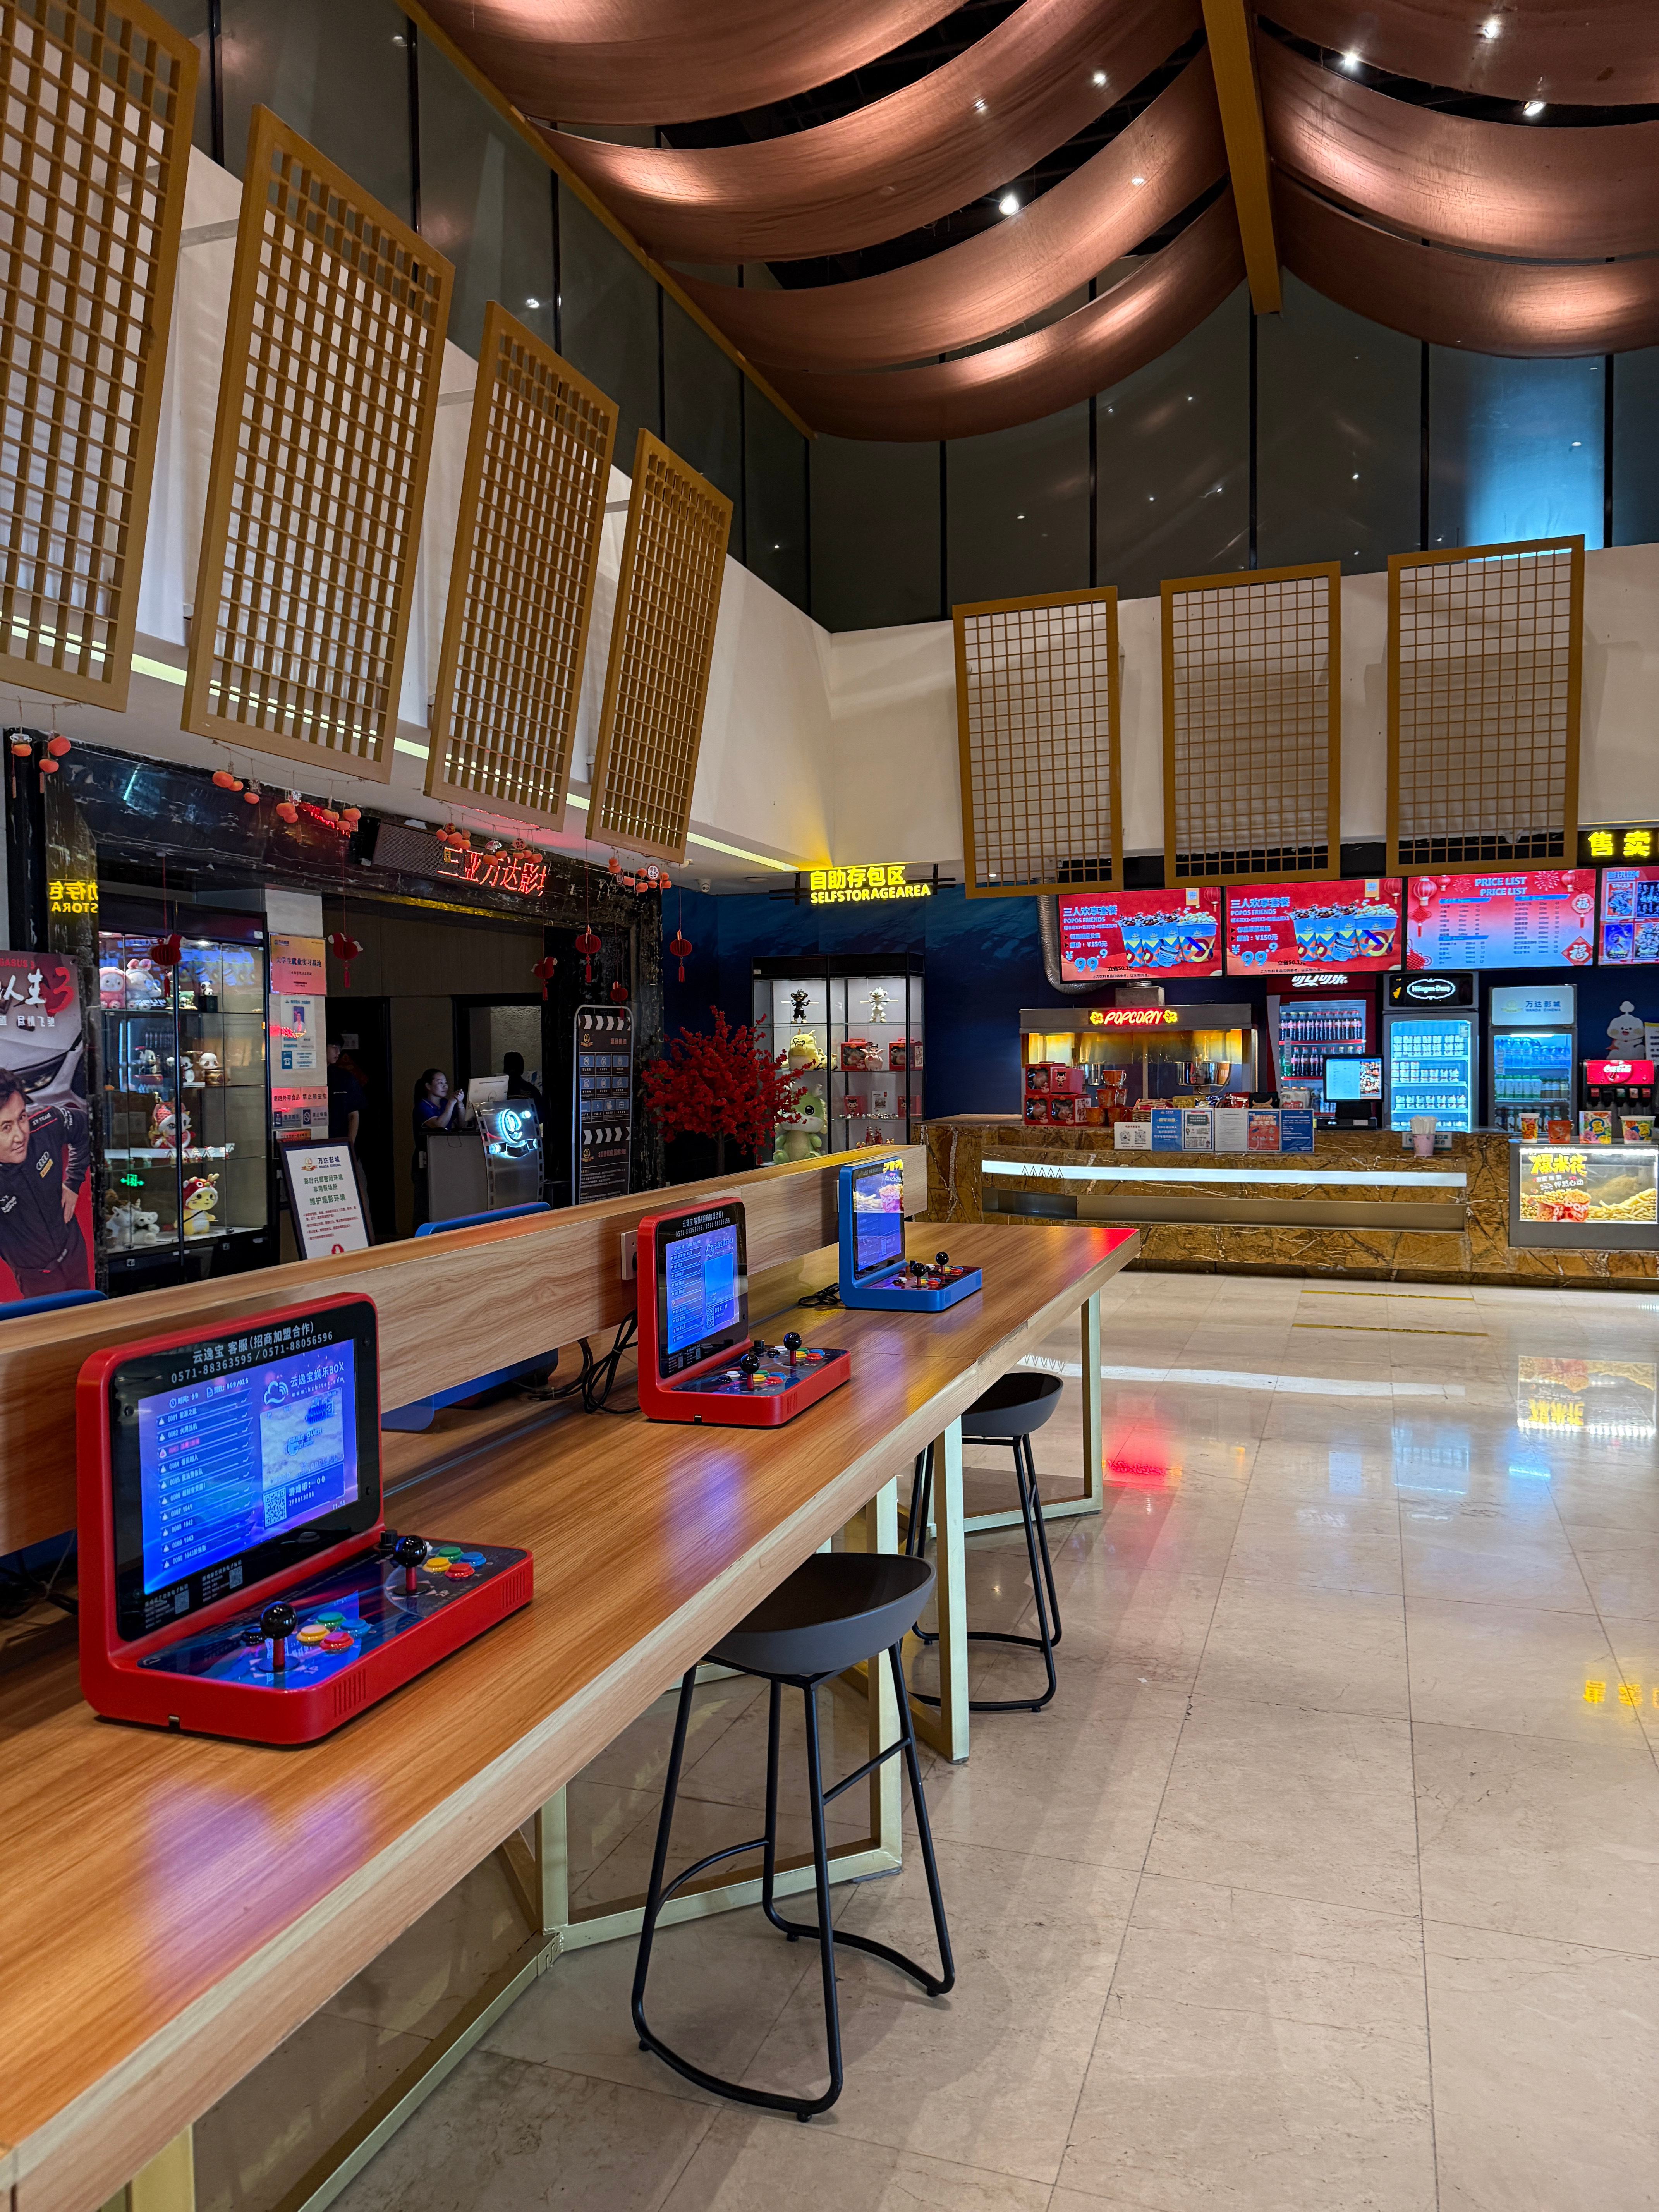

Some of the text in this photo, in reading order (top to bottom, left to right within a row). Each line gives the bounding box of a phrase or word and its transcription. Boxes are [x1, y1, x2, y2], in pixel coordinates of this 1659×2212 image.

[1588, 831, 1650, 856] 售卖
[810, 865, 906, 891] 自助存包区
[1475, 876, 1527, 887] PRICE LIST
[811, 884, 931, 903] SELFSTORAGEAREA
[1480, 887, 1528, 896] PRICE LIST
[1230, 896, 1290, 909] 三人欢享套餐
[1576, 897, 1589, 909] 福
[1063, 905, 1118, 917] 三人欢享套餐
[1569, 944, 1589, 962] 福
[1291, 974, 1348, 987] 可口可乐
[1104, 1010, 1163, 1025] POPCORN
[318, 1156, 340, 1164] 万达影城
[1528, 1153, 1587, 1177] 爆米花
[172, 1353, 252, 1384] 0571-88363595
[263, 1331, 333, 1359] 0571-88056596
[192, 1344, 224, 1364] 云逸宝
[290, 1361, 345, 1388] 云逸宝娱乐BOX
